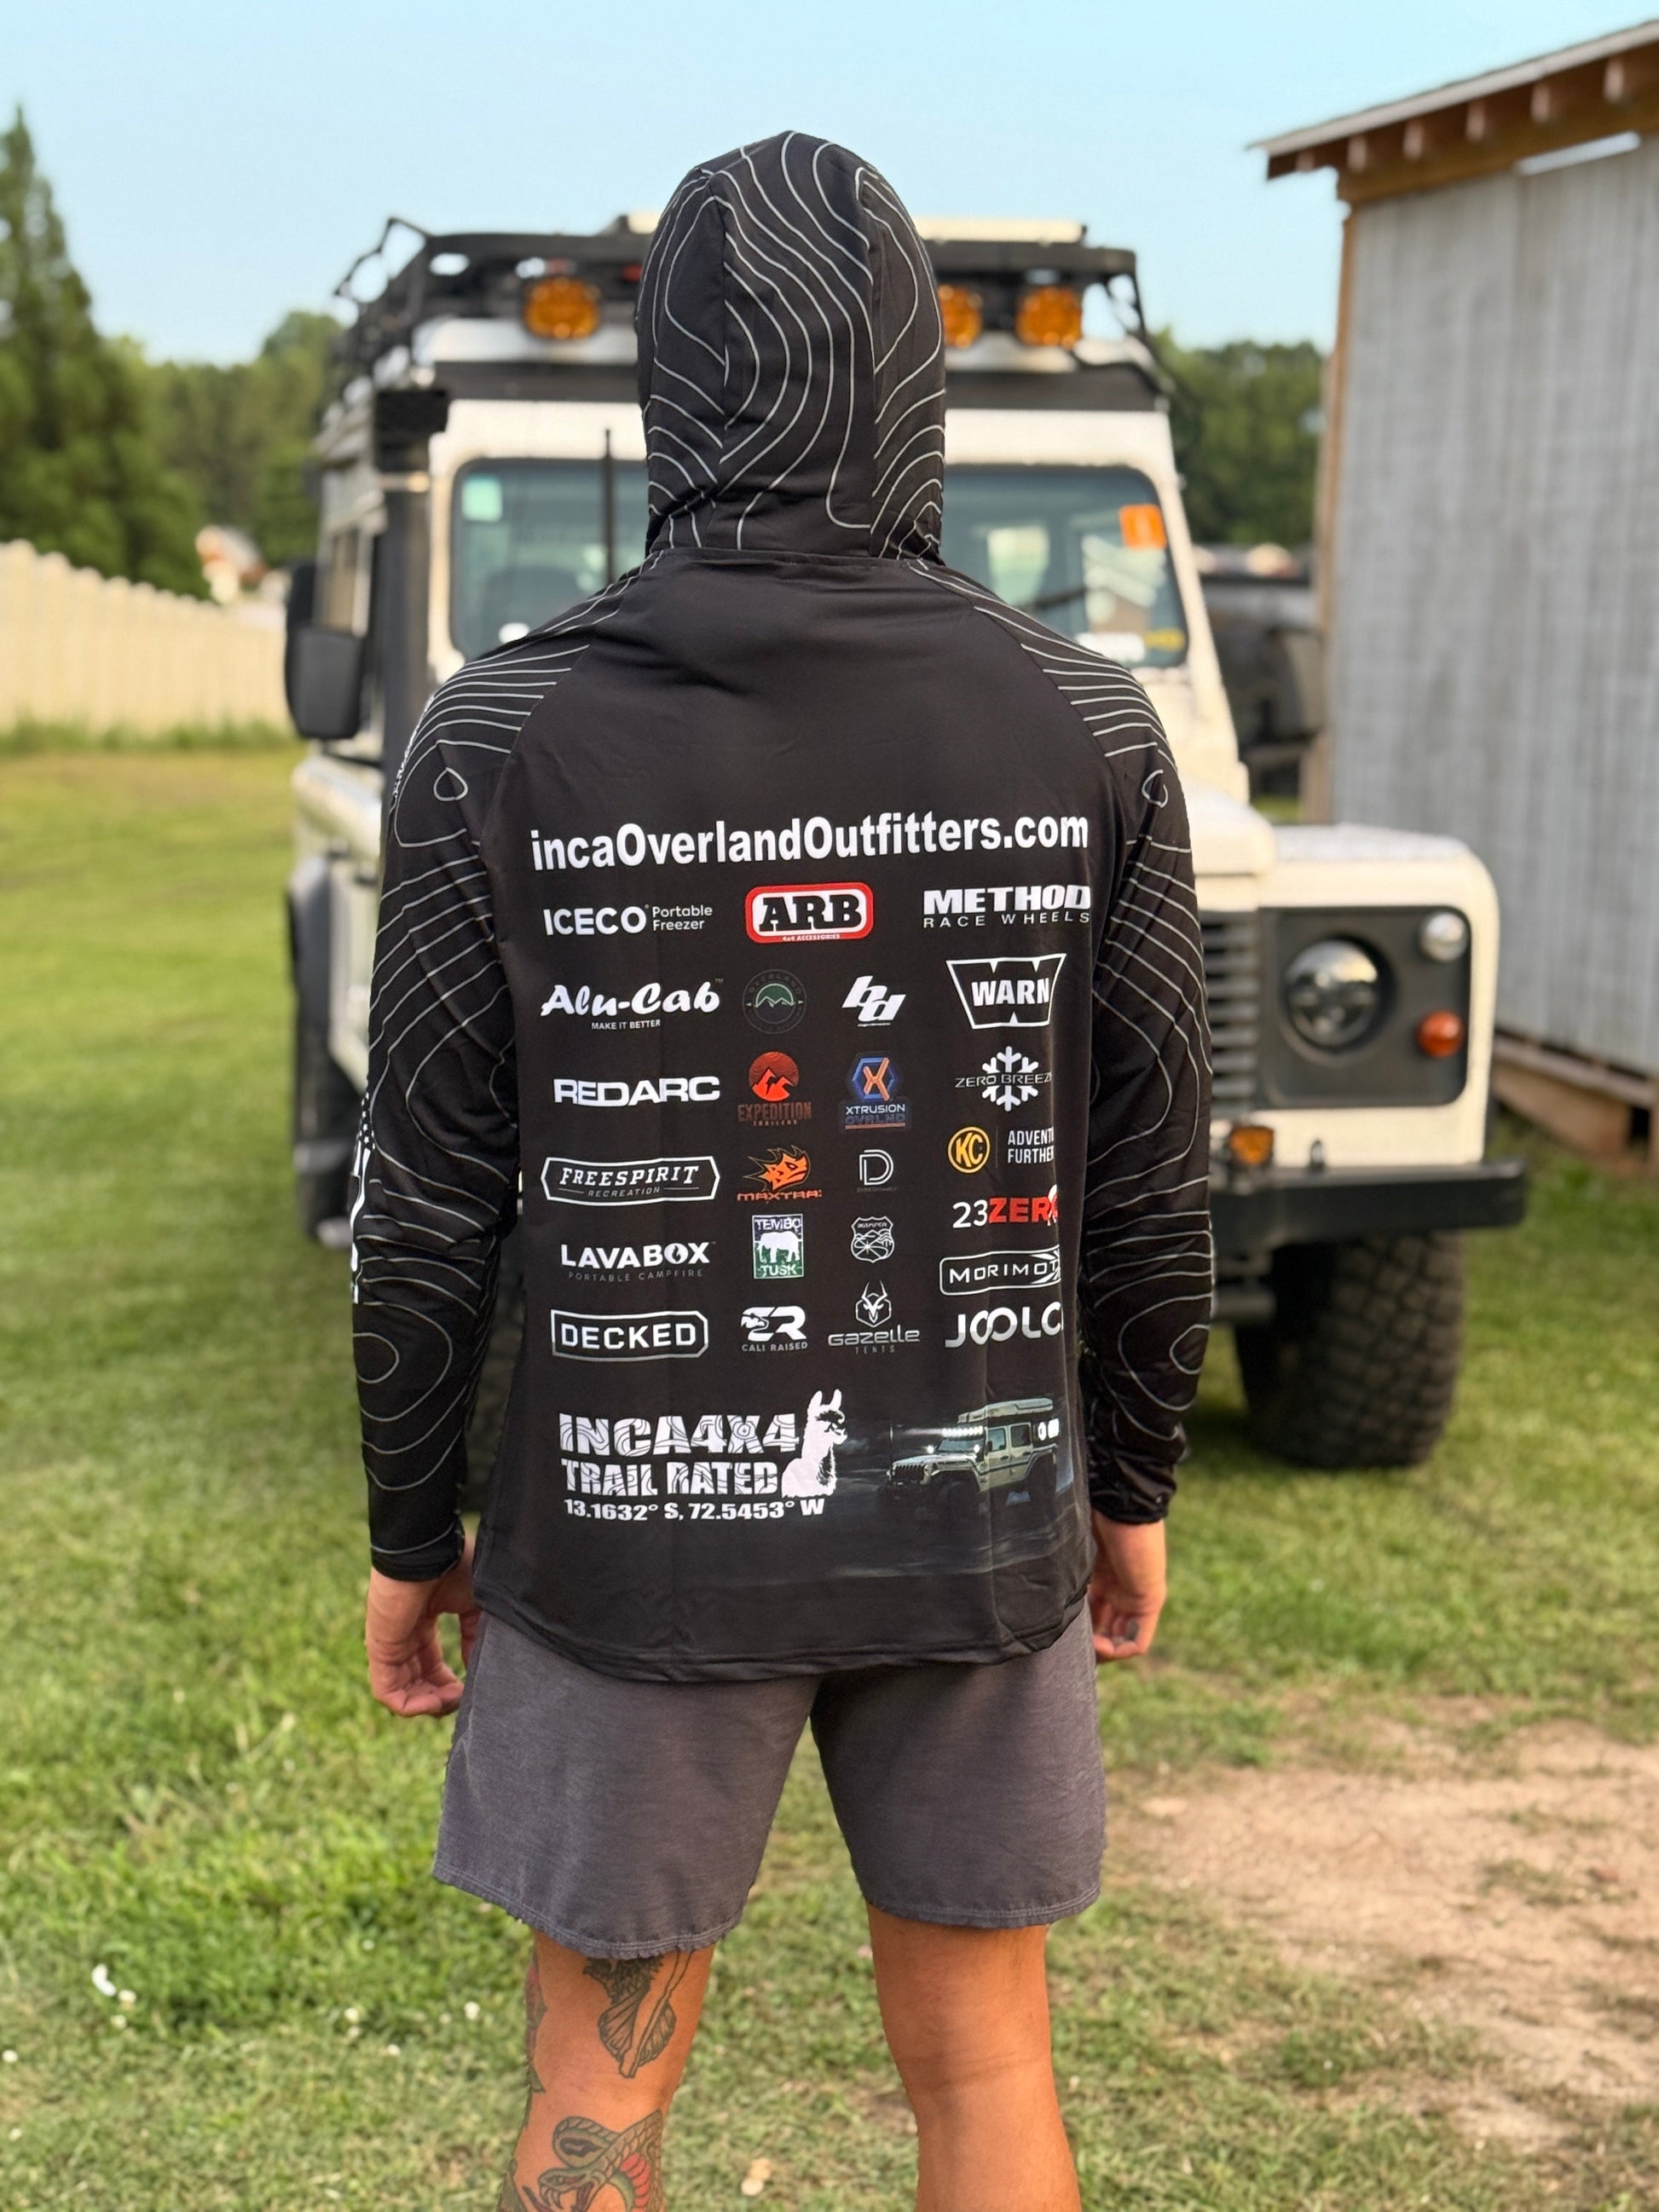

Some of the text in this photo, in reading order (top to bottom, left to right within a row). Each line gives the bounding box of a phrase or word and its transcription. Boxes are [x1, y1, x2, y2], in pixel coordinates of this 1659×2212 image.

[530, 811, 1089, 870] incaOverlandOutfitters.com
[923, 885, 1091, 915] METHOD
[543, 906, 646, 935] ICECO
[652, 904, 713, 918] Portable
[759, 894, 862, 932] ARB
[923, 911, 1090, 928] RACE WHEELS
[652, 919, 704, 931] Freezer
[540, 981, 720, 1016] Alu-Cab
[971, 978, 1049, 1007] WARN
[629, 1019, 661, 1029] BETTER
[955, 1071, 1052, 1088] ZERO BREEZ
[554, 1077, 720, 1106] REDARC
[737, 1101, 812, 1122] EXPEDITION
[846, 1104, 905, 1115] XTRUSION
[955, 1132, 983, 1168] KC
[559, 1166, 699, 1186] FREESPIRIT
[588, 1187, 661, 1197] RECREATION
[754, 1217, 802, 1231] TEMBO
[561, 1242, 710, 1269] LAVABOX
[569, 1268, 703, 1282] PORTABLE CAMPFIRE
[760, 1263, 798, 1276] TUSK
[561, 1323, 696, 1350] DECKED
[828, 1325, 921, 1347] Gazelle
[742, 1342, 808, 1352] CALI RAISED
[855, 1345, 895, 1354] TENTS
[559, 1413, 800, 1457] INCA4X4
[561, 1458, 777, 1496] TRAIL RATED
[564, 1499, 824, 1521] 13.1632° S, 72.5453° W
